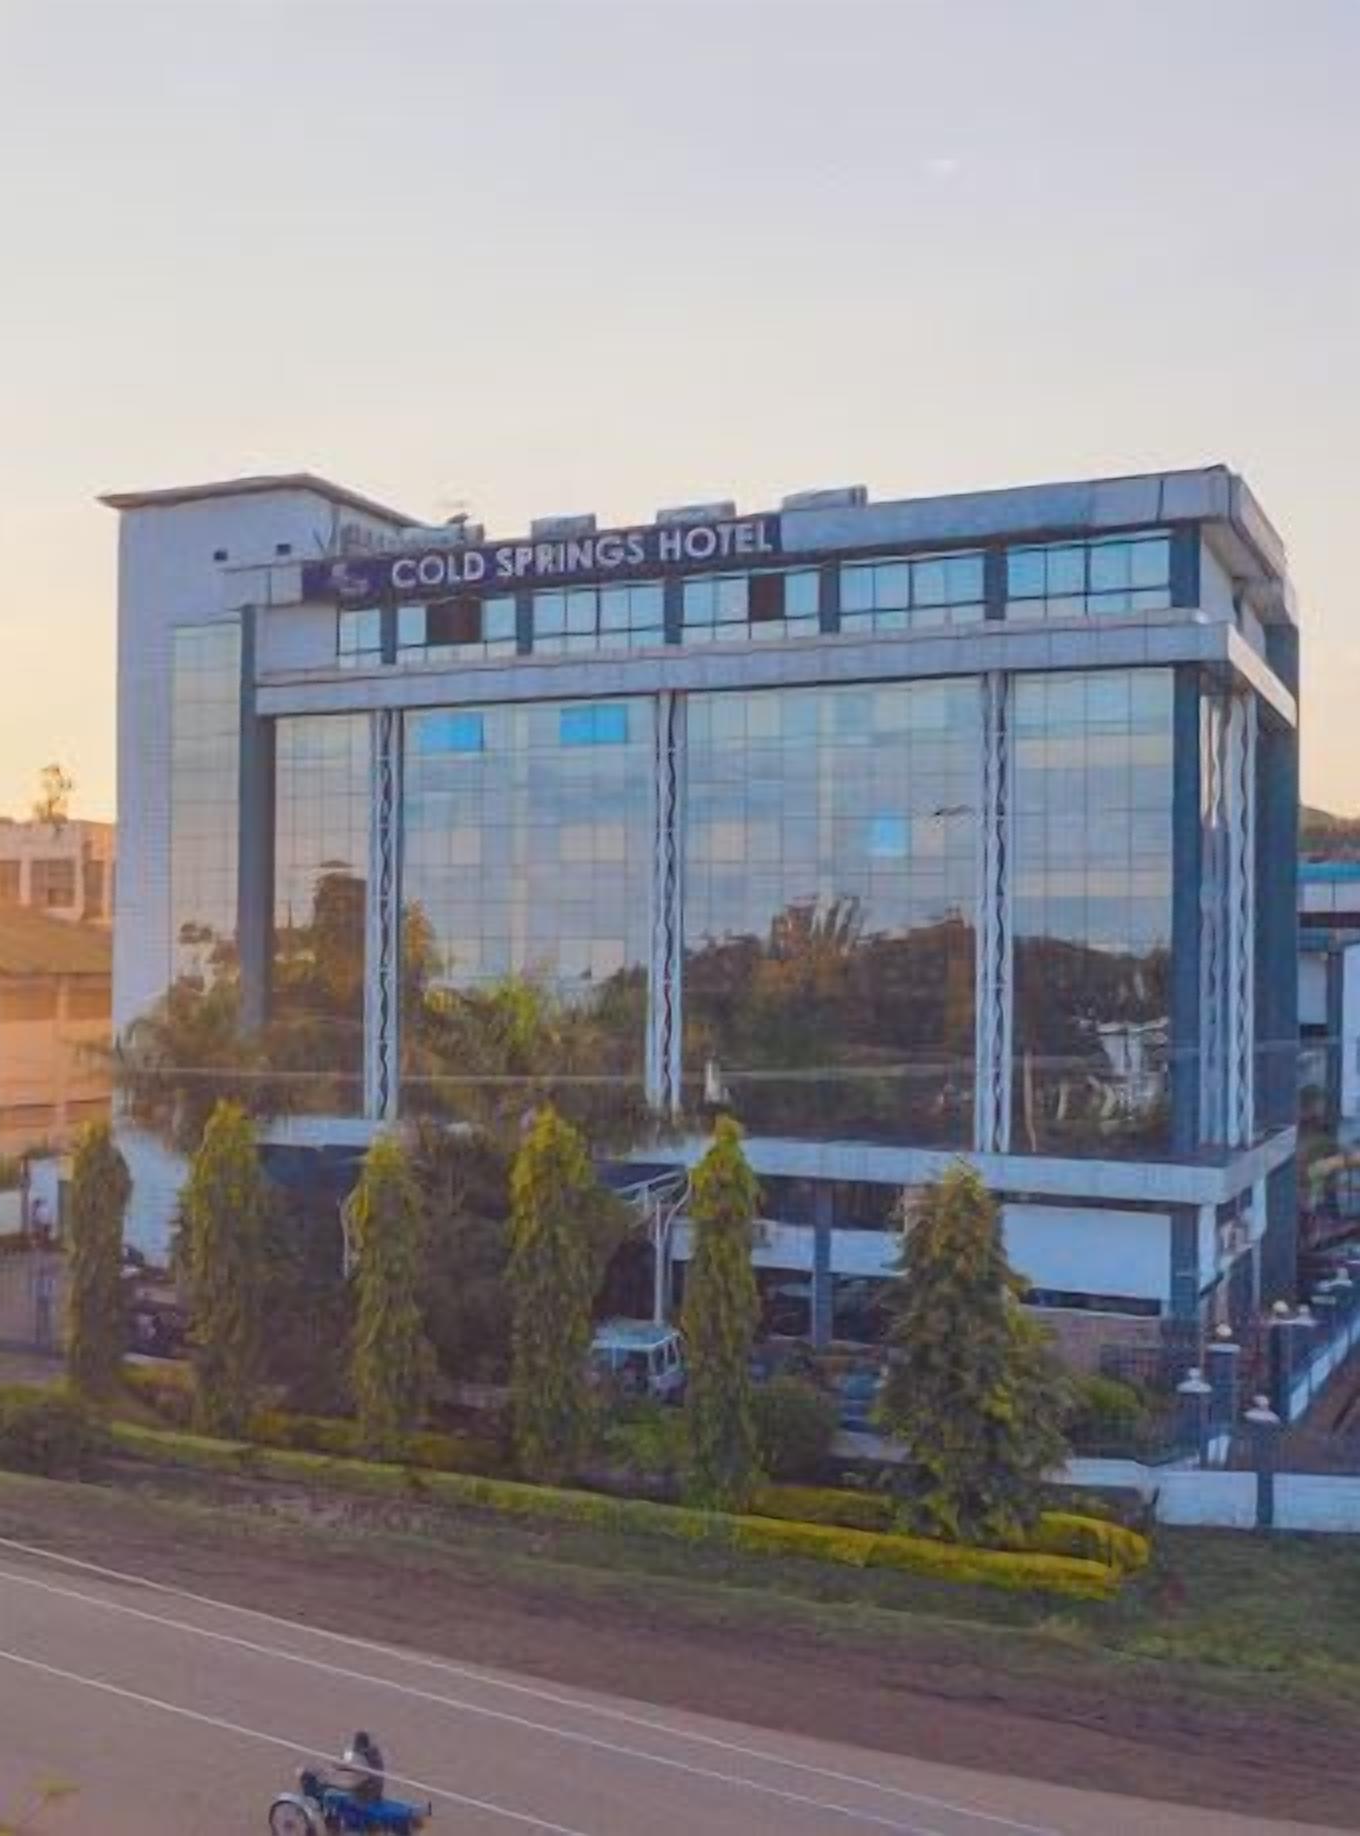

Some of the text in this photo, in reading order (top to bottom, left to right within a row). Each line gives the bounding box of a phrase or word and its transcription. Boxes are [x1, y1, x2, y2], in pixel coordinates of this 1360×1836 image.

[392, 521, 773, 588] COLD SPRINGS HOTEL
